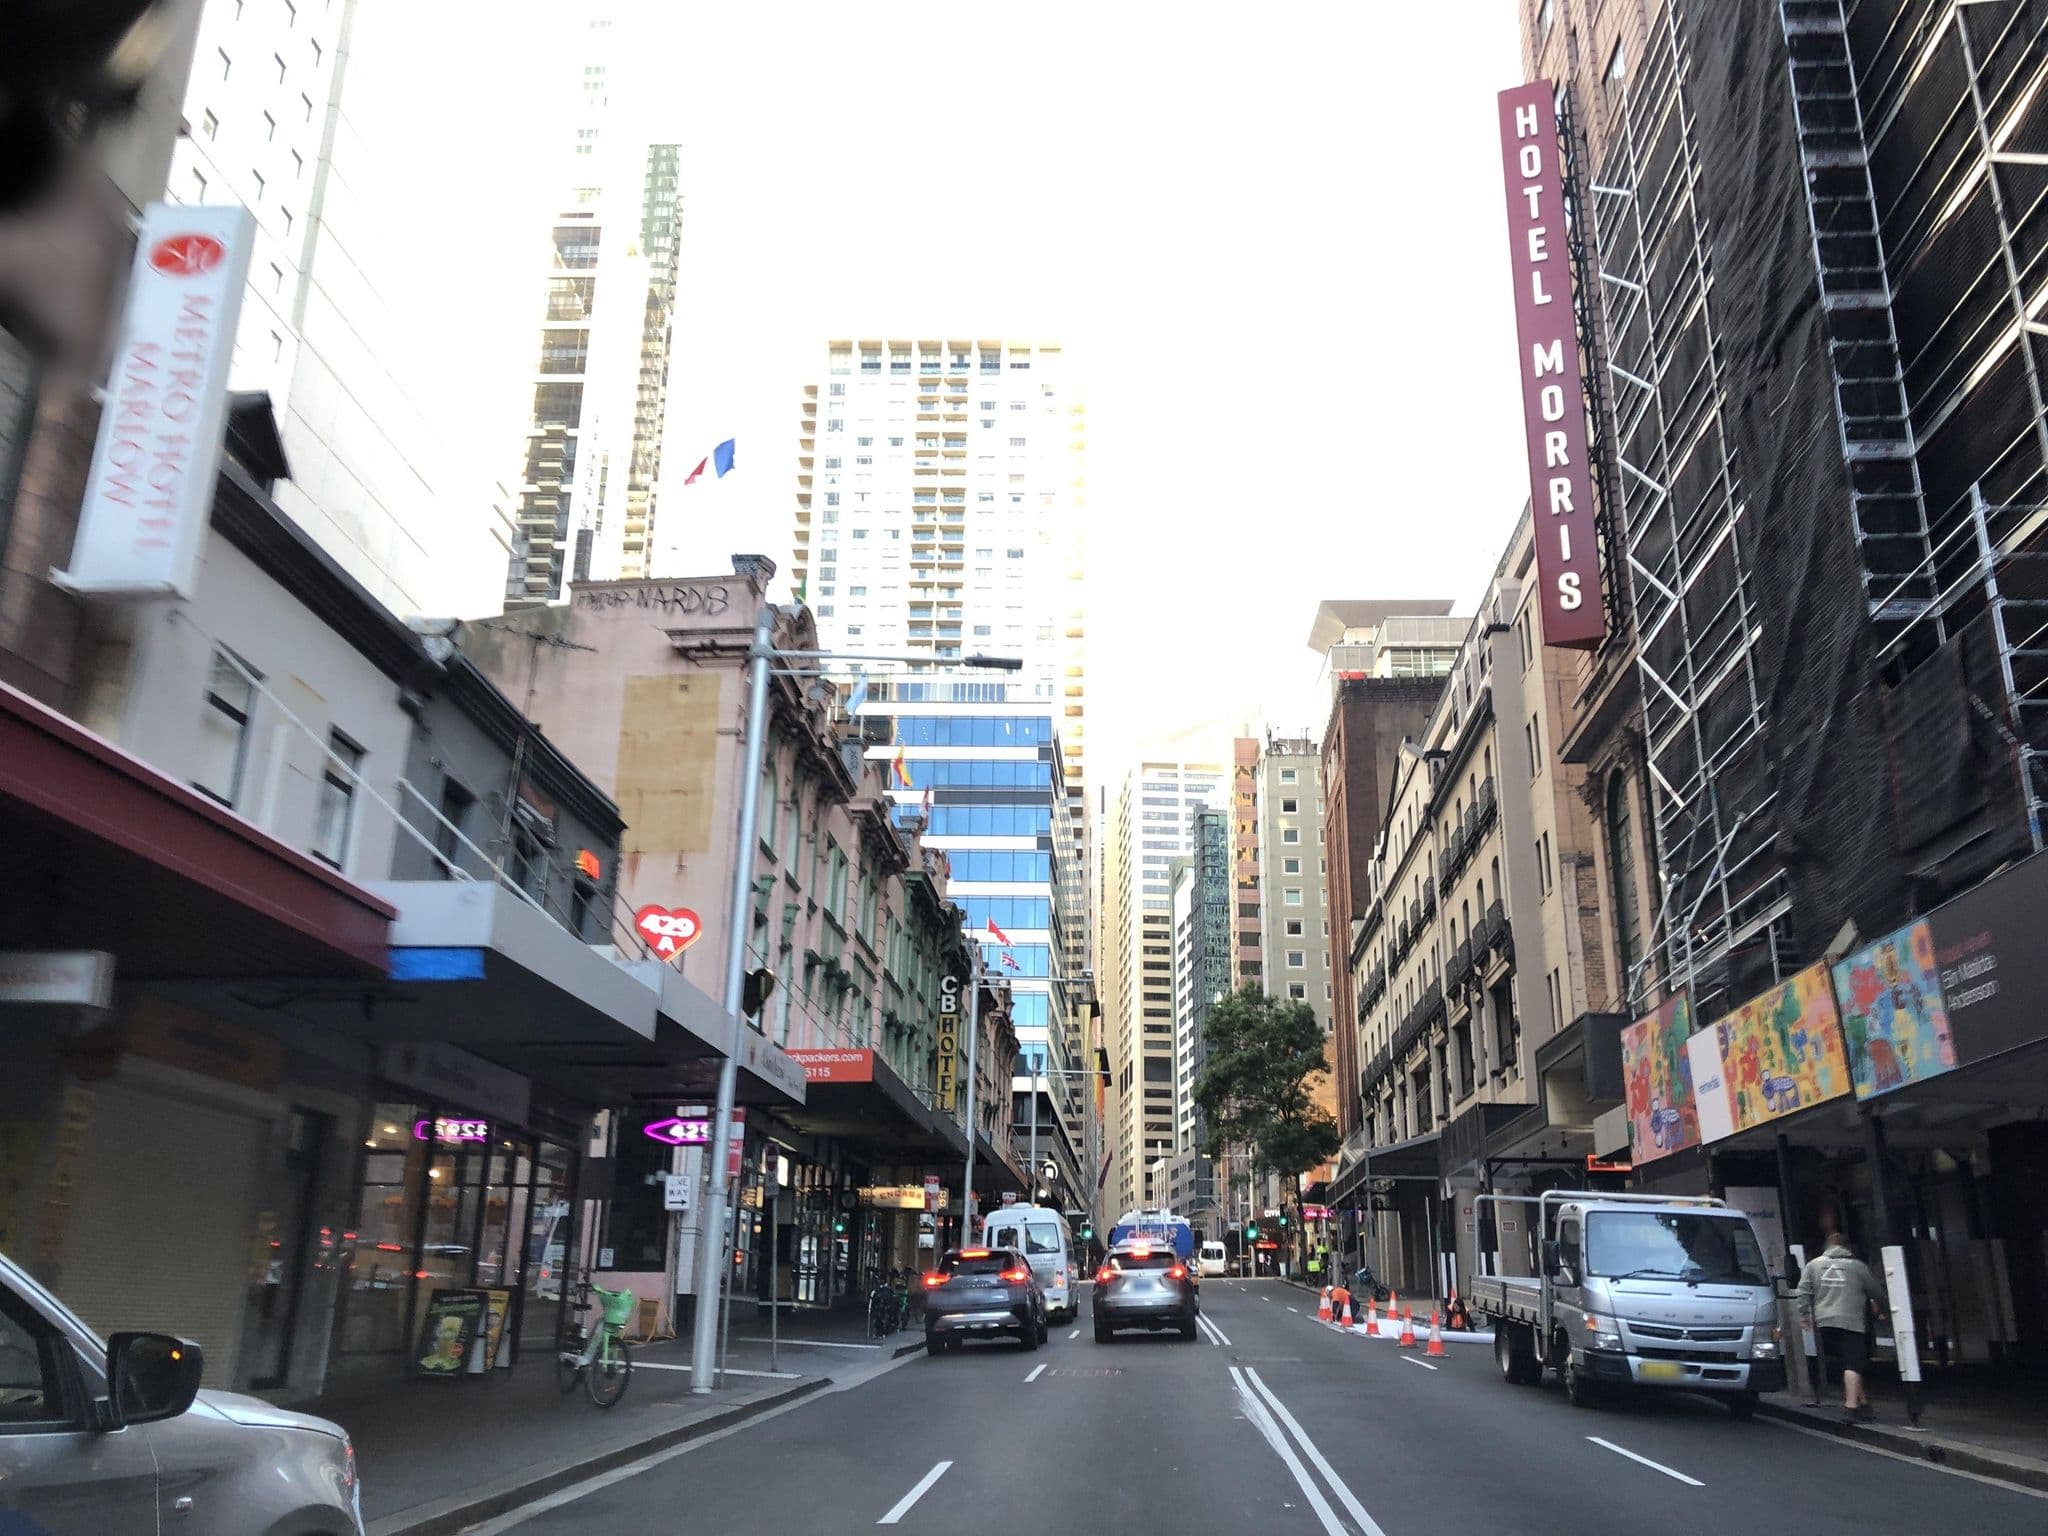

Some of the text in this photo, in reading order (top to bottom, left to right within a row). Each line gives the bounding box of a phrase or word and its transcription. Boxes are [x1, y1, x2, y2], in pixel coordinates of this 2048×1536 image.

[101, 340, 161, 508] MARLOW
[159, 292, 215, 424] METRO
[1514, 103, 1583, 611] HOTEL MORRIS
[640, 913, 696, 938] 429
[656, 935, 676, 954] A
[940, 975, 958, 1111] CB HOTEL
